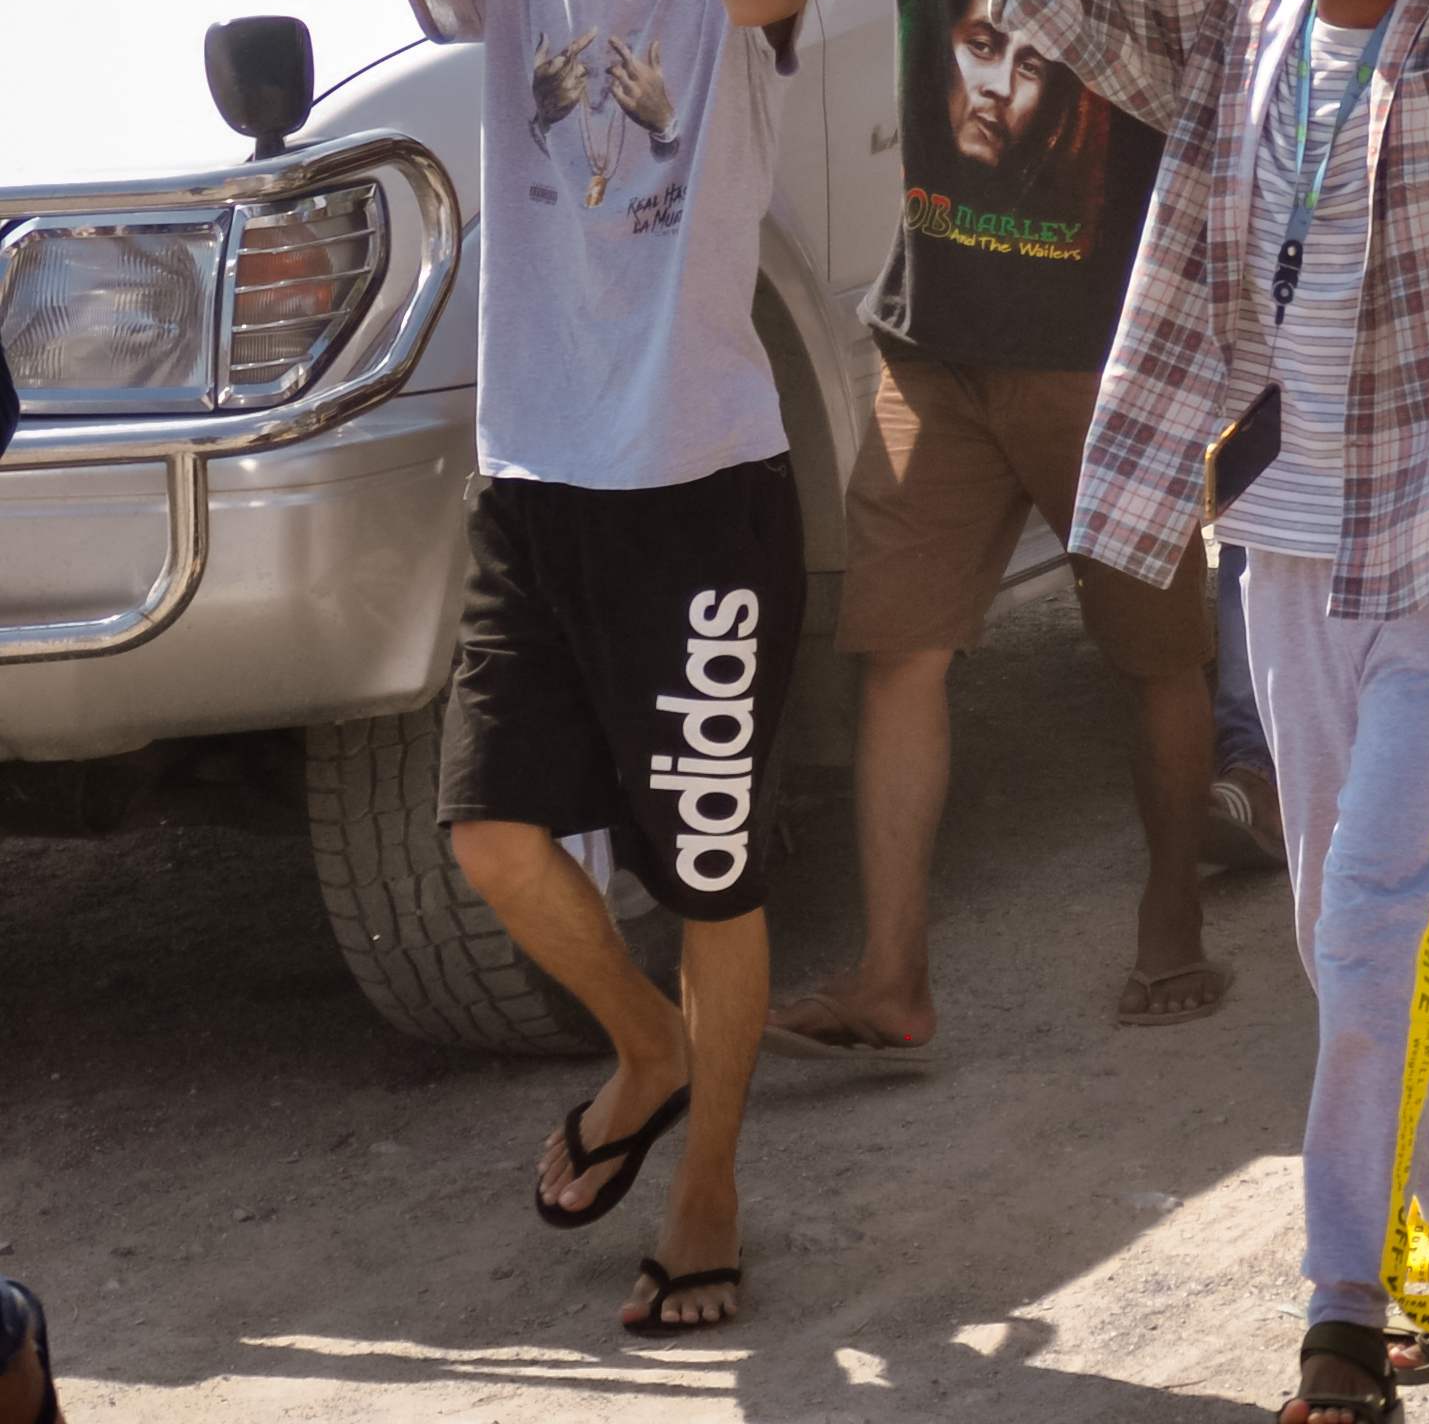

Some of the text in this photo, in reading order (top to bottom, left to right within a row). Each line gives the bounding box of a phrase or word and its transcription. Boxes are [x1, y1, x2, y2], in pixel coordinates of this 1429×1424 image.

[949, 228, 1083, 262] And The Wailers
[649, 588, 759, 892] adidas
